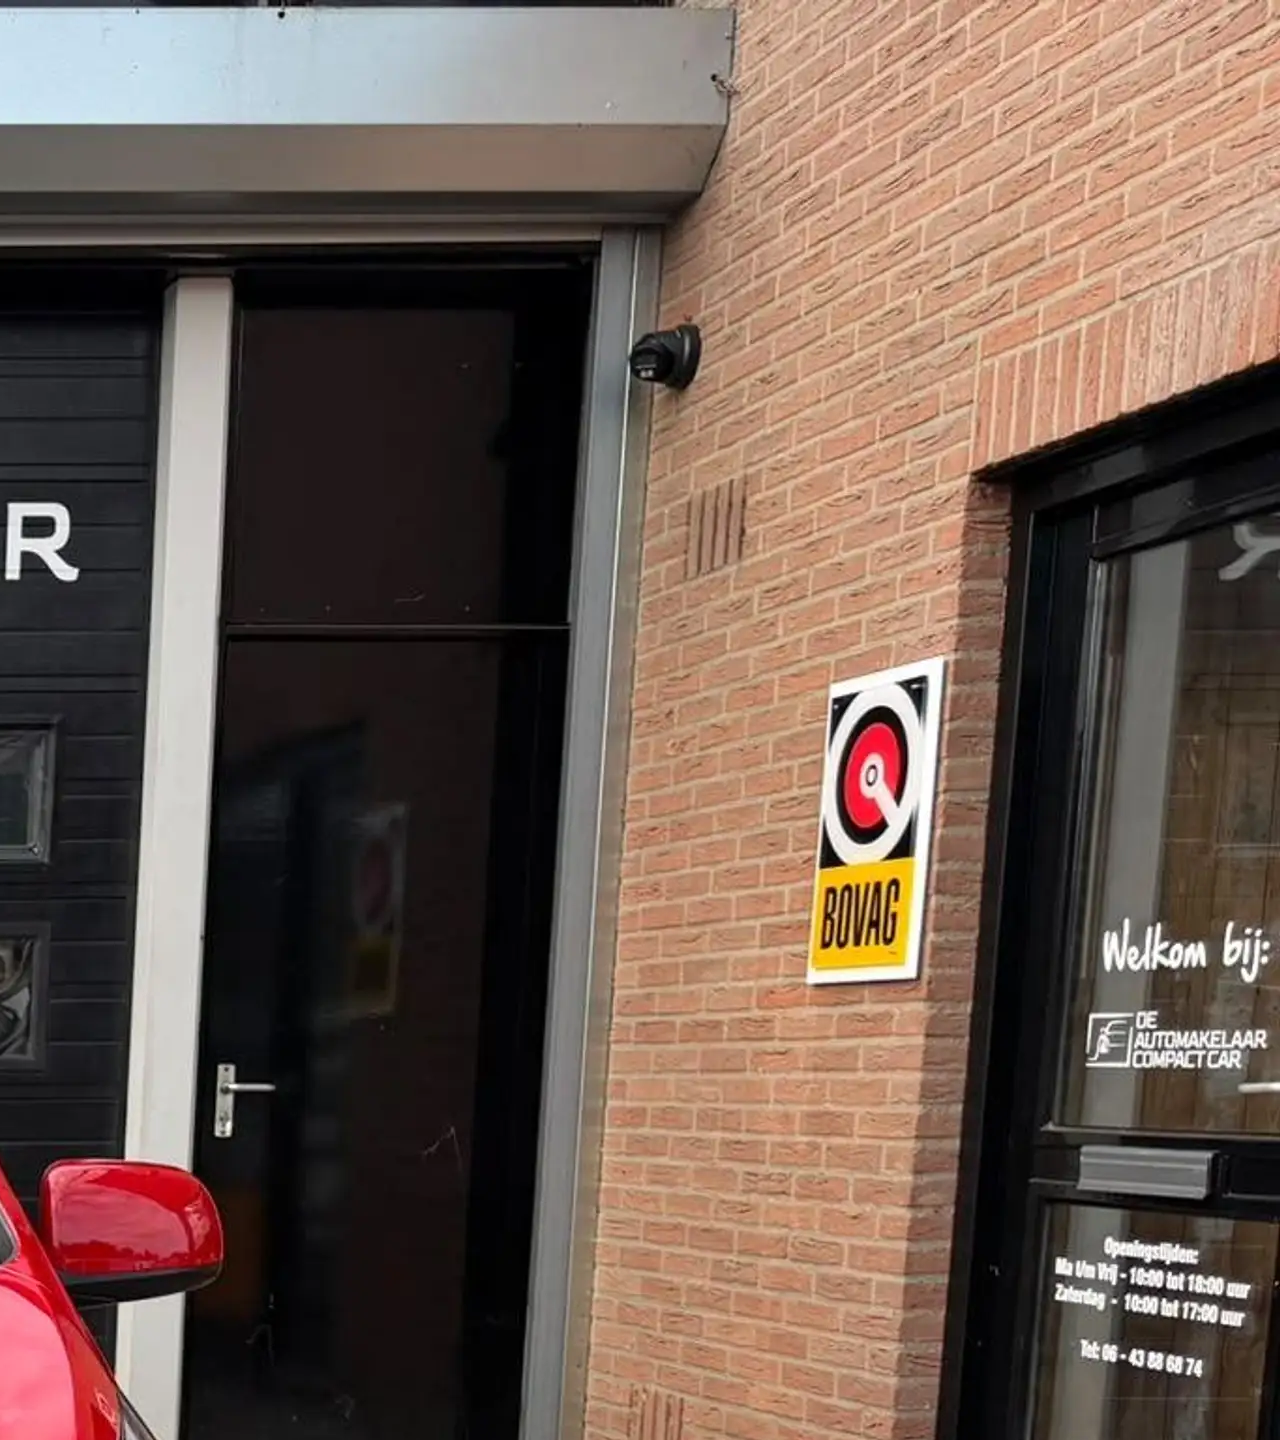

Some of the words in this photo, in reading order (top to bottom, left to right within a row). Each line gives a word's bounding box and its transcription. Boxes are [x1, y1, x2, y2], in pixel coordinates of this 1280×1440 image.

[820, 878, 901, 950] BOVAG
[1103, 918, 1206, 972] Welkom
[1223, 922, 1270, 982] bij:
[1136, 1011, 1157, 1029] DE
[1134, 1030, 1267, 1049] AUTOMAKELAAR
[1132, 1049, 1203, 1069] COMPACT
[1207, 1050, 1241, 1068] CAR
[1104, 1236, 1199, 1265] Openingstijden:
[1055, 1257, 1074, 1277] Ma
[1097, 1262, 1119, 1286] Vrij
[1129, 1266, 1165, 1288] 10:00
[1165, 1271, 1186, 1291] tot
[1187, 1273, 1225, 1296] 18:00
[1225, 1282, 1252, 1299] uur
[1054, 1283, 1107, 1311] Zaterdag
[1124, 1293, 1159, 1315] 10:00
[1160, 1297, 1180, 1318] tot
[1182, 1301, 1219, 1324] 17:00
[1220, 1309, 1246, 1327] uur
[1101, 1343, 1118, 1363] 06
[1128, 1348, 1146, 1368] 43
[1185, 1357, 1203, 1378] 74
